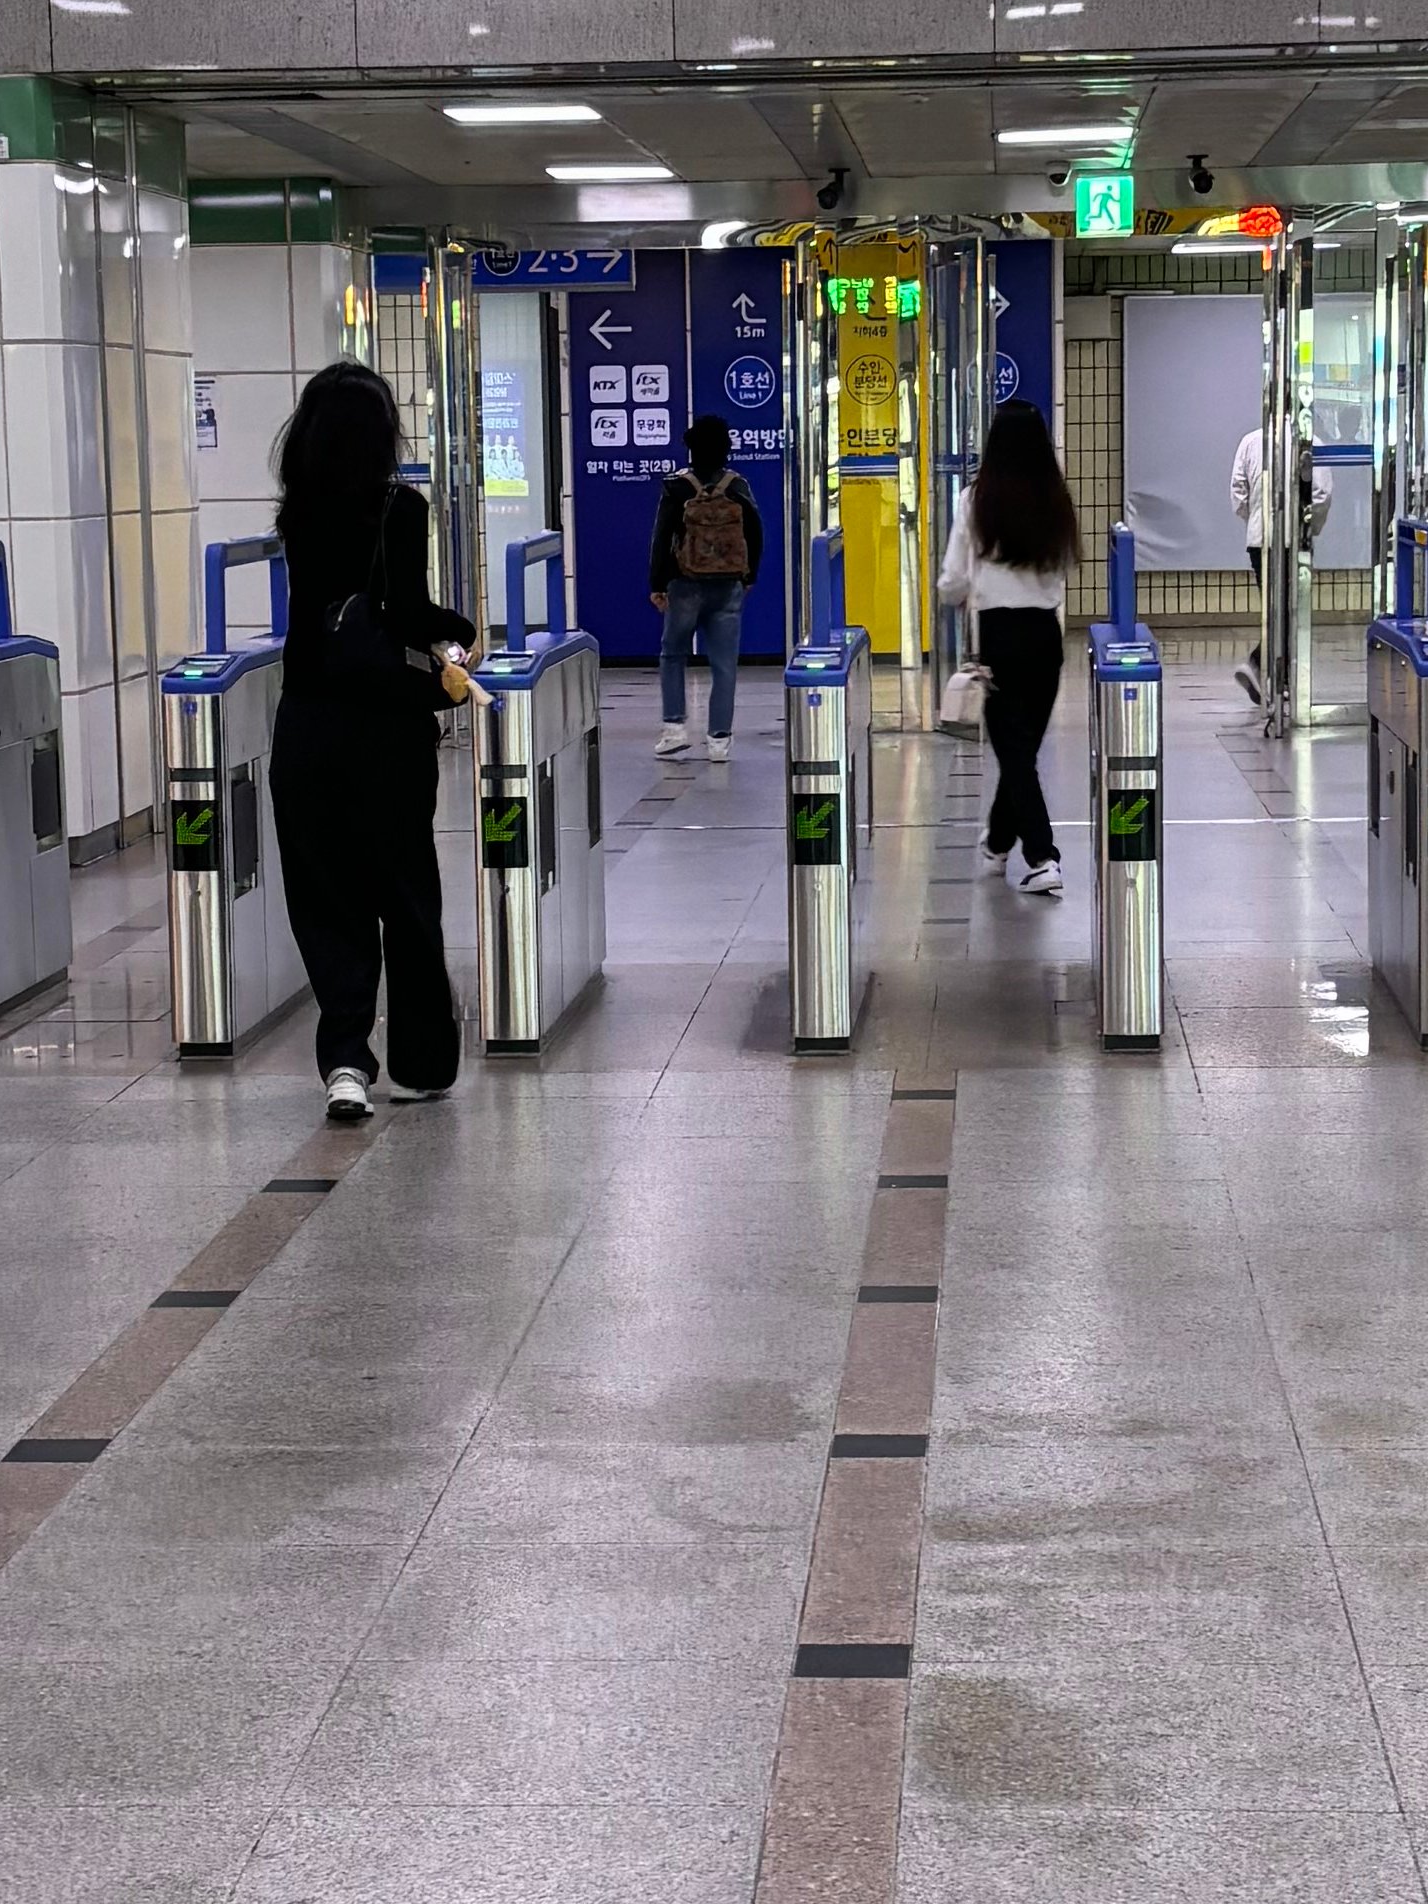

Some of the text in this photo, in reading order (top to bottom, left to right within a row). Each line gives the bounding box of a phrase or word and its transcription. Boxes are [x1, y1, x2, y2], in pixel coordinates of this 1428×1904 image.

[735, 326, 765, 338] 15m
[593, 378, 621, 391] KTX
[729, 370, 770, 389] 1호선
[728, 428, 795, 450] 울역방면
[586, 460, 609, 474] 열차
[613, 460, 634, 473] 타는
